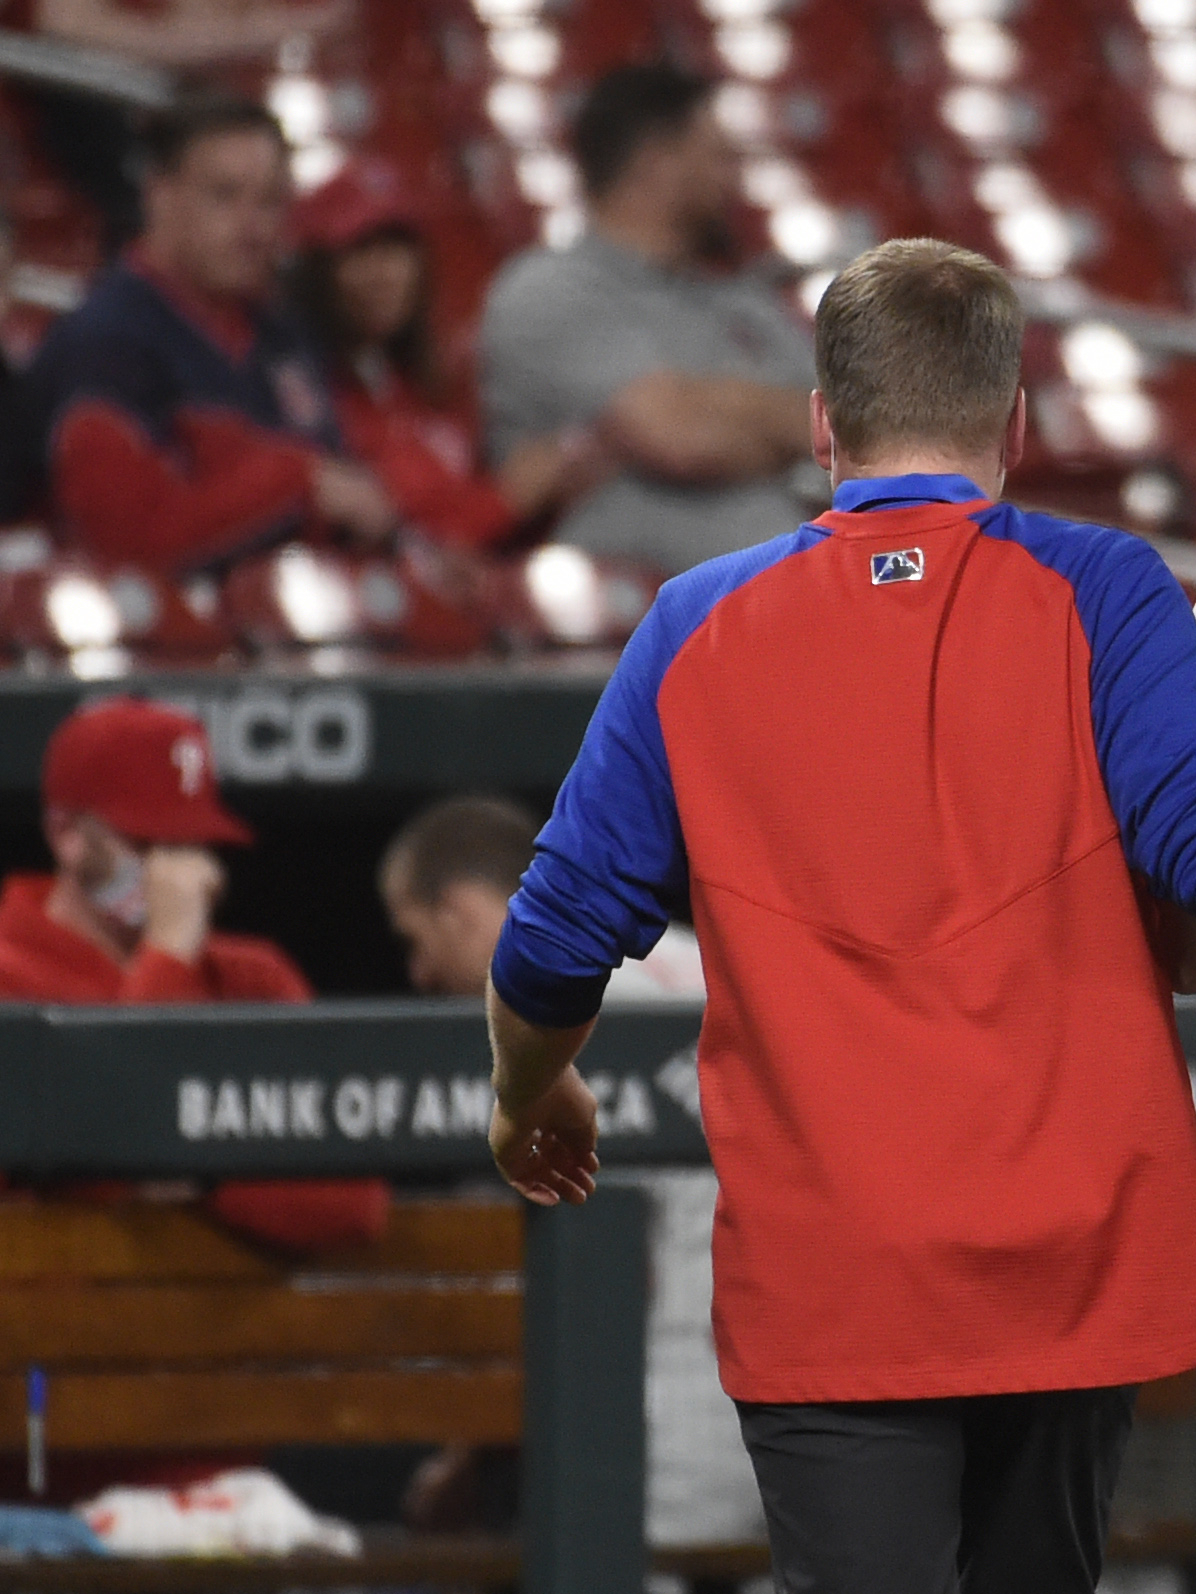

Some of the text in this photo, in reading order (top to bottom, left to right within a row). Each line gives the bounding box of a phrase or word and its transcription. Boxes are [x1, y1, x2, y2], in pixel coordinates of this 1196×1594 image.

[209, 686, 371, 783] ICO
[177, 1075, 324, 1140] BANK
[334, 1075, 401, 1140] OF
